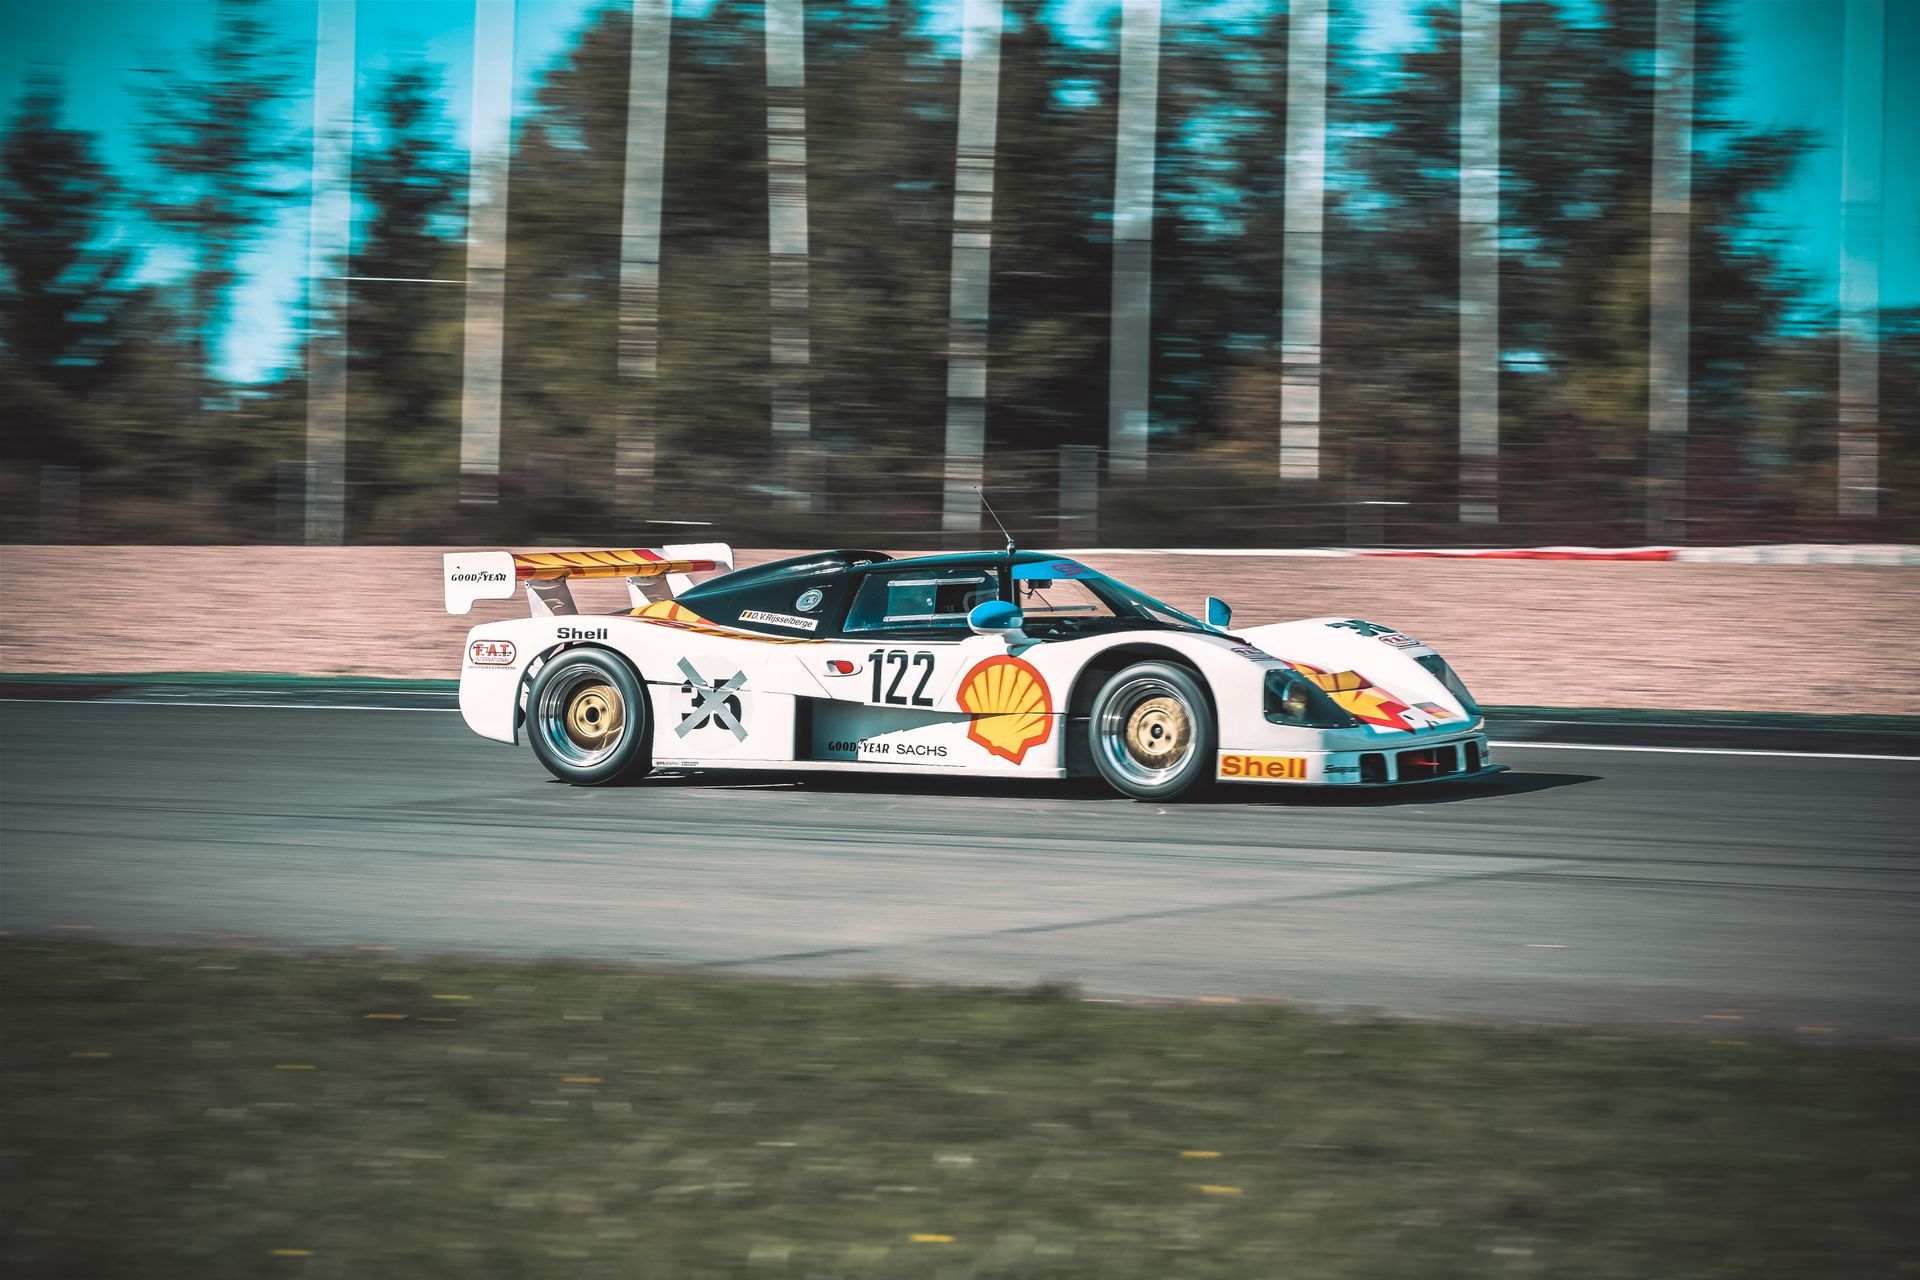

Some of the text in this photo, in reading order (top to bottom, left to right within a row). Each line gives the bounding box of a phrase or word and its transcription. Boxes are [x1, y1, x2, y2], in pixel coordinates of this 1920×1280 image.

[557, 627, 608, 640] Shell
[868, 648, 935, 707] 122
[896, 743, 948, 757] SACHS
[1221, 755, 1306, 778] Shell
